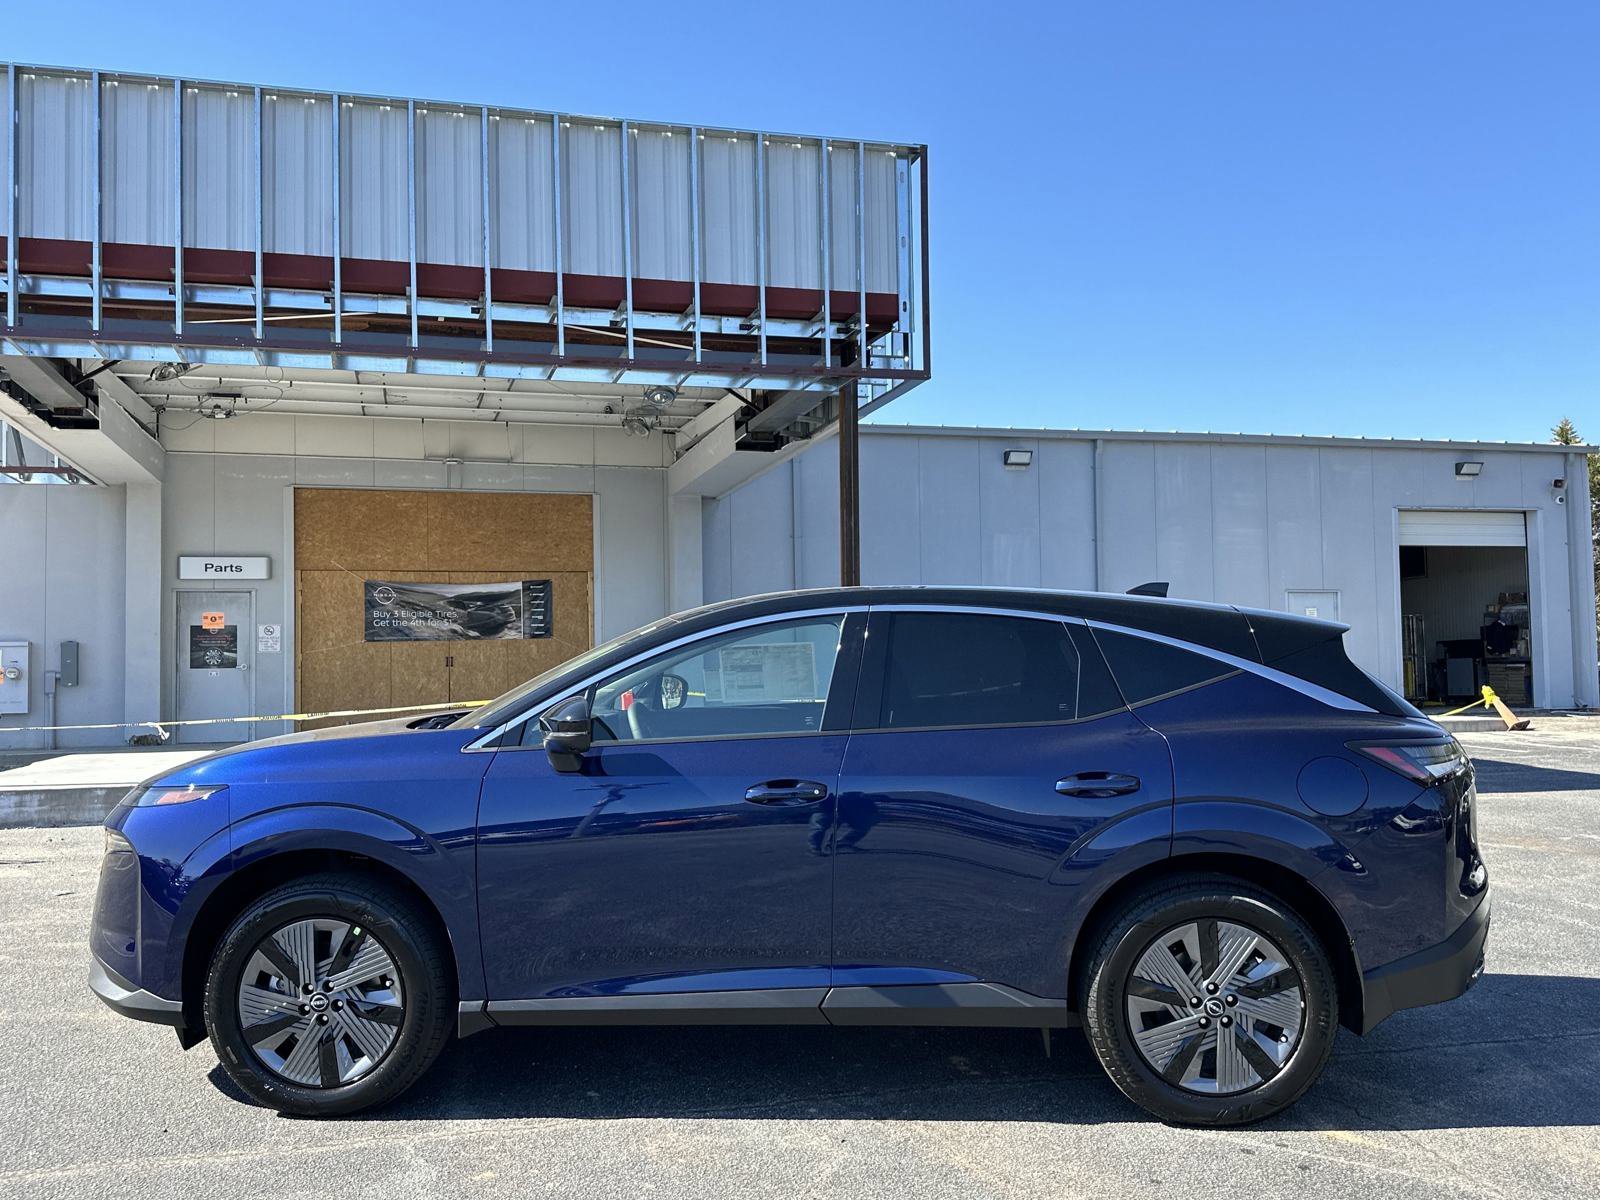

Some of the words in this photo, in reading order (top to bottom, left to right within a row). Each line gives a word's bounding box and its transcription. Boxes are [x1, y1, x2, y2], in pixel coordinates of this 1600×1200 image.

[204, 563, 243, 573] Parts
[373, 610, 391, 619] Buy
[393, 610, 399, 618] 3
[401, 610, 433, 619] Eligible
[435, 610, 459, 619] Tires,
[373, 619, 390, 627] Get
[392, 619, 408, 627] the
[410, 619, 425, 627] 4th
[427, 619, 441, 627] for
